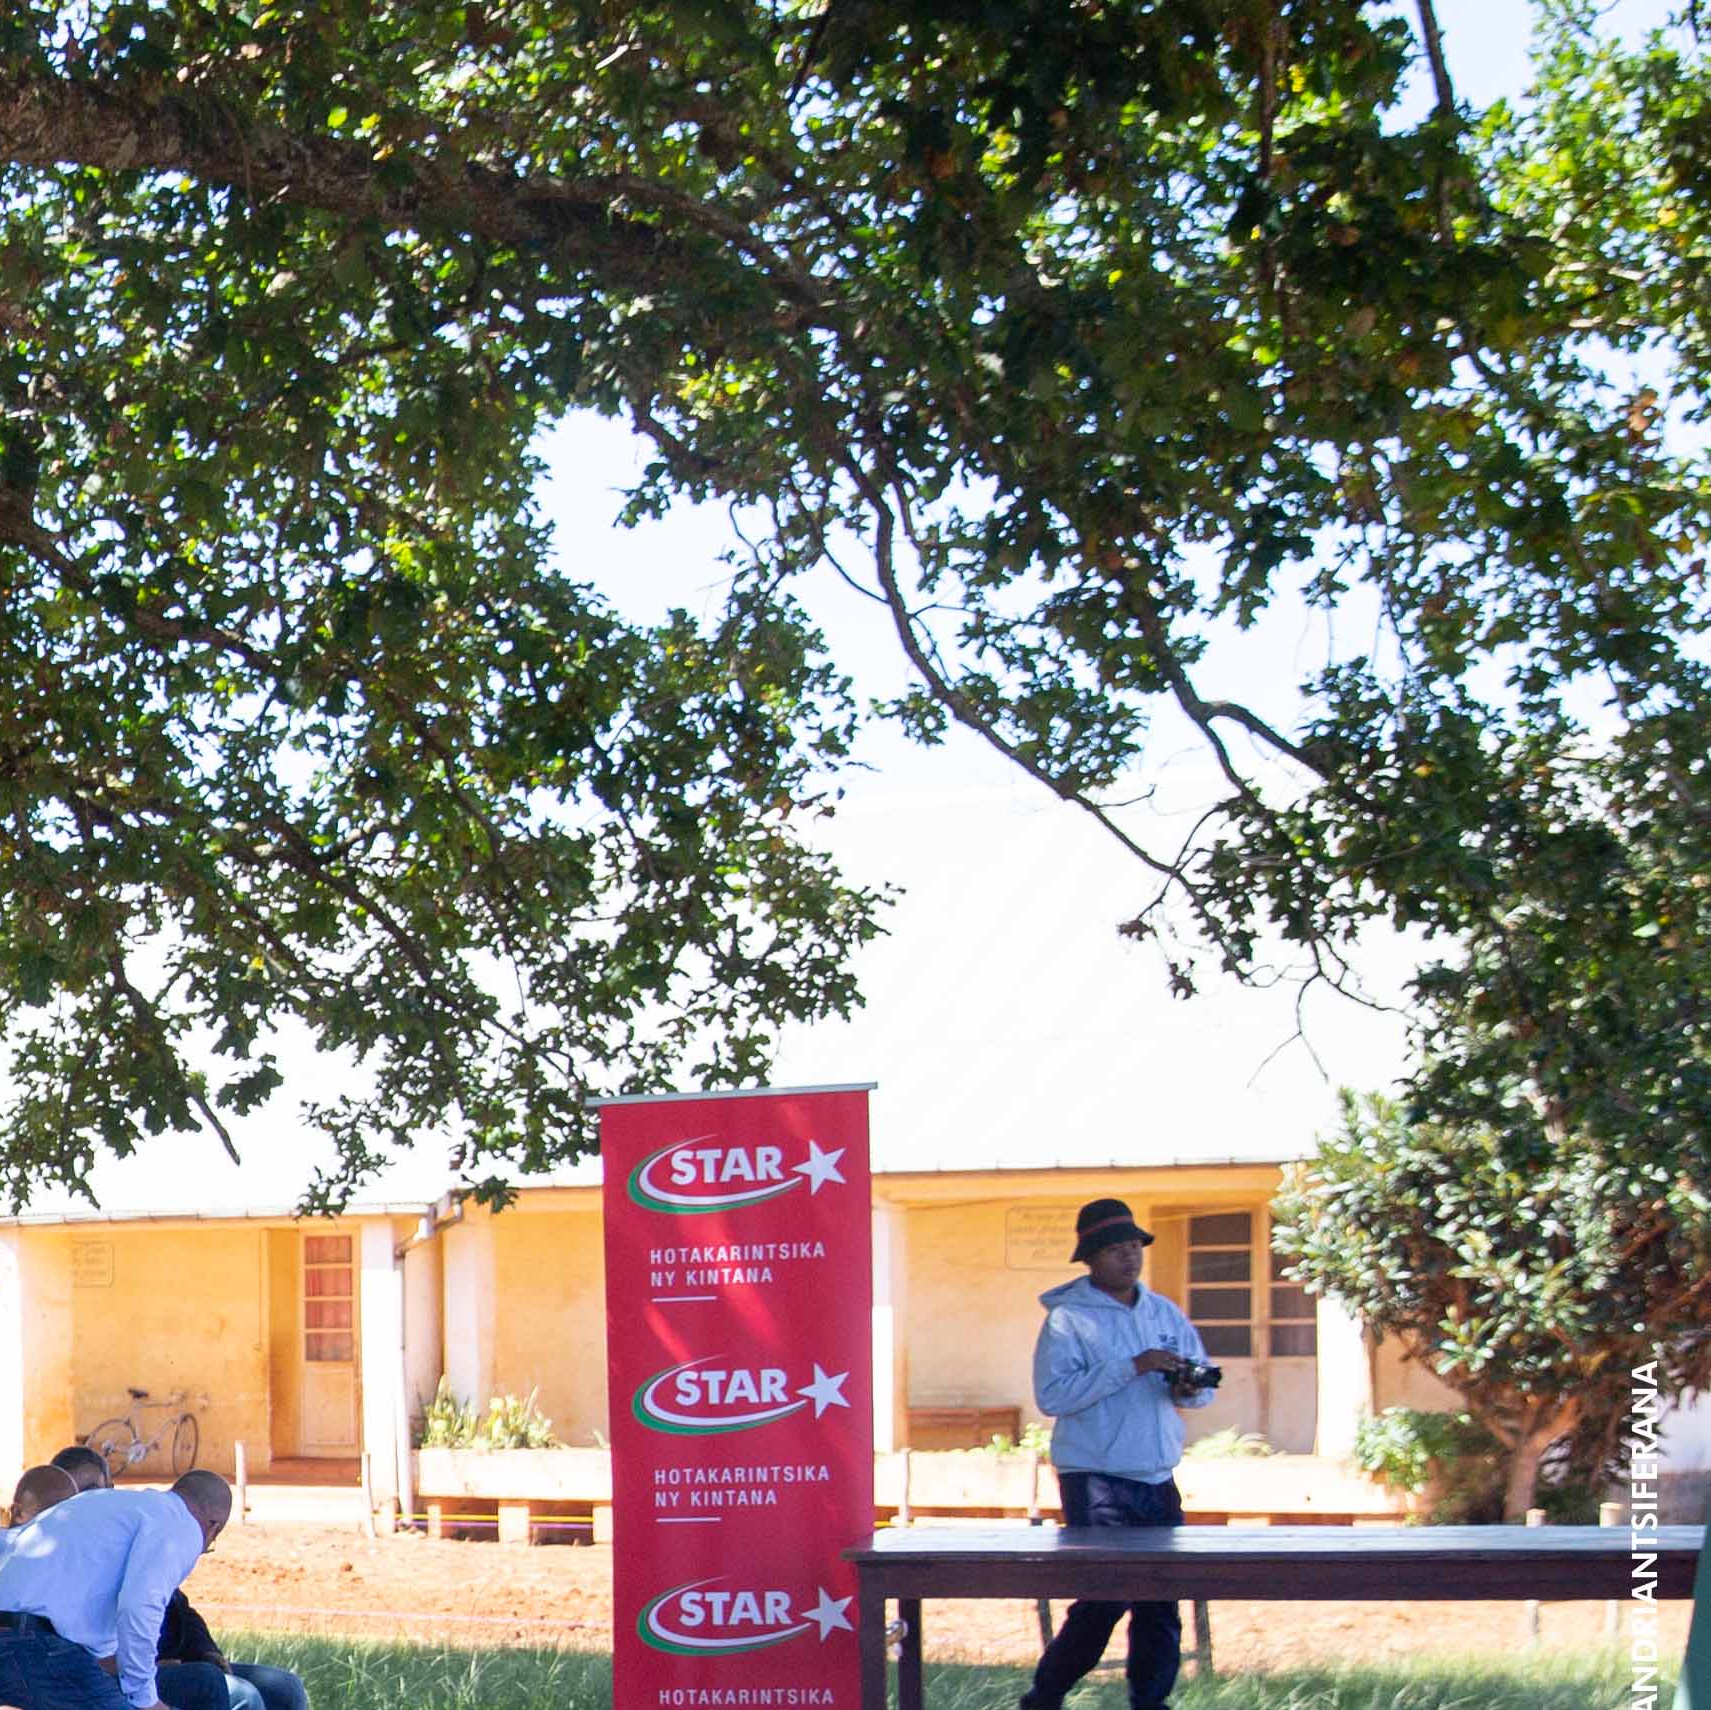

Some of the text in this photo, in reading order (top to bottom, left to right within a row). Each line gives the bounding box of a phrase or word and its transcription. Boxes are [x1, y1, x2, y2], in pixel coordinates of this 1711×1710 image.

[671, 1147, 784, 1185] STAR
[650, 1242, 825, 1264] HOTAKARINTSIKA
[650, 1267, 773, 1287] NY KINTANA
[675, 1369, 788, 1406] STAR
[654, 1464, 831, 1485] HOTAKARINTSIKA
[654, 1489, 777, 1507] NY KINTANA
[679, 1591, 792, 1626] STAR
[659, 1688, 834, 1706] HOTAKARINTSIKA
